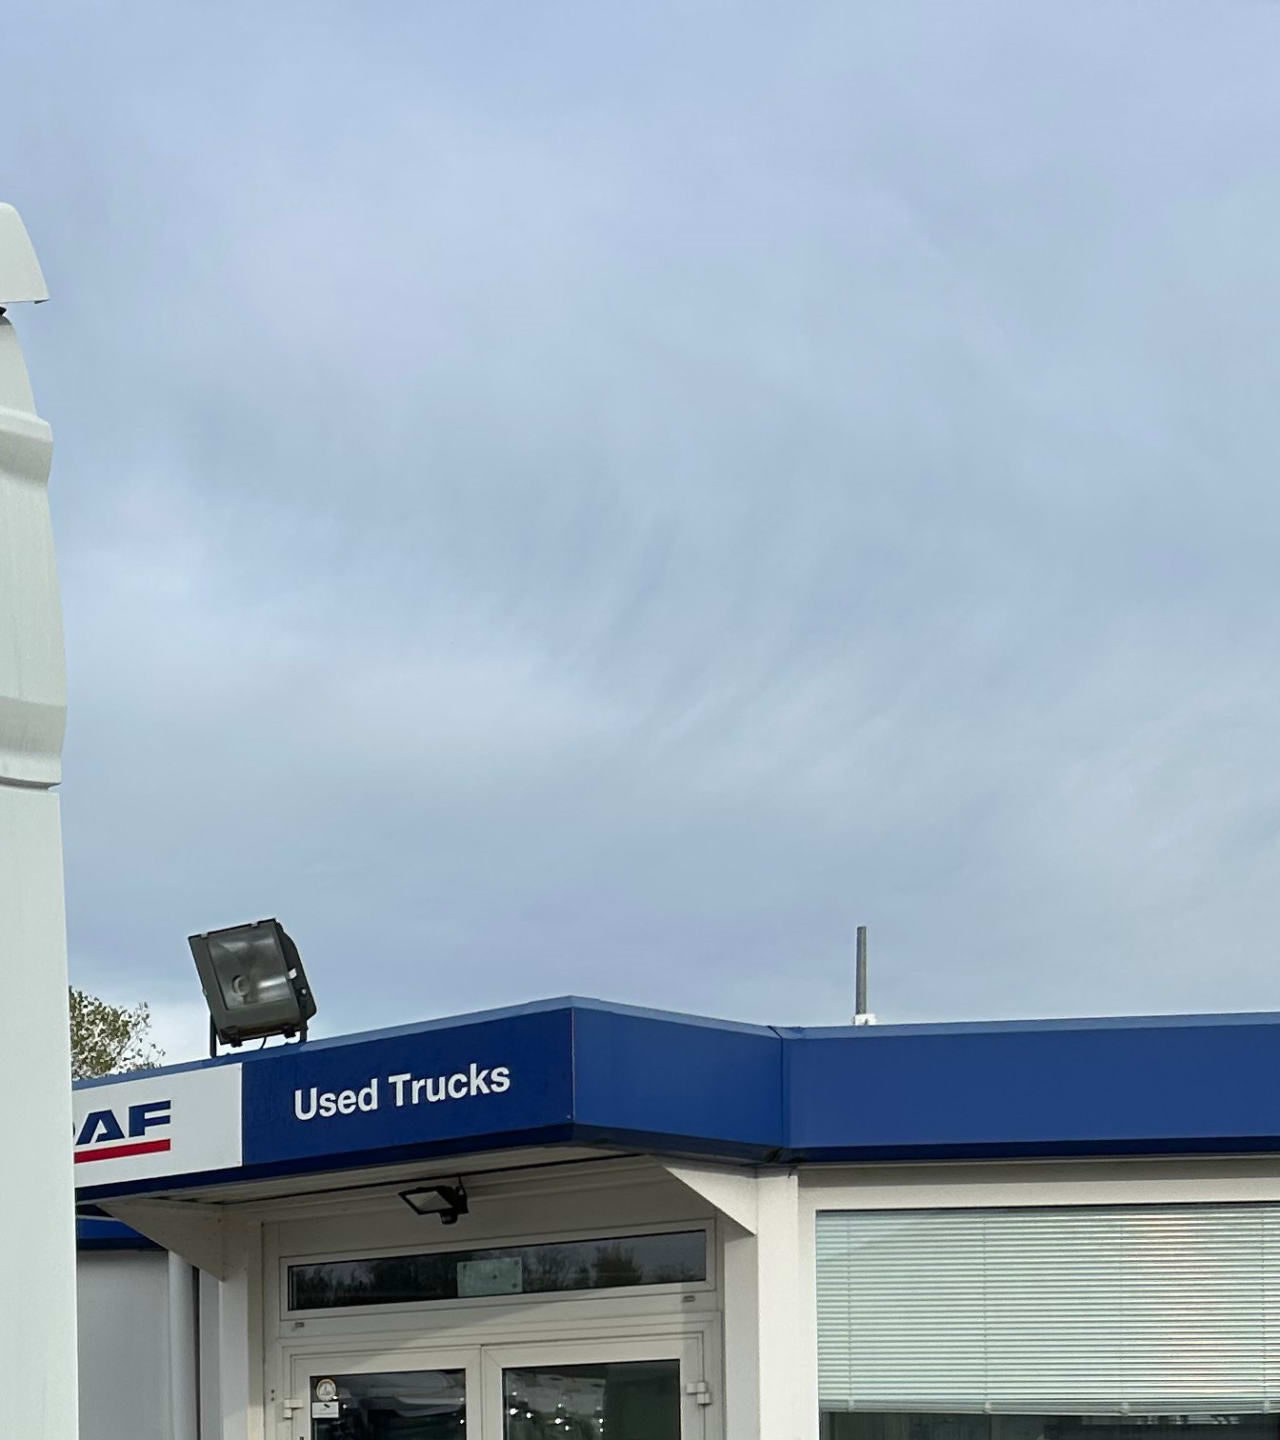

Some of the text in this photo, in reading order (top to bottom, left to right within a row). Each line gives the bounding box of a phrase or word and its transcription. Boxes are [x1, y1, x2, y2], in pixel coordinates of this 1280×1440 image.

[294, 1062, 511, 1121] Used Trucks
[72, 1099, 172, 1146] AF
